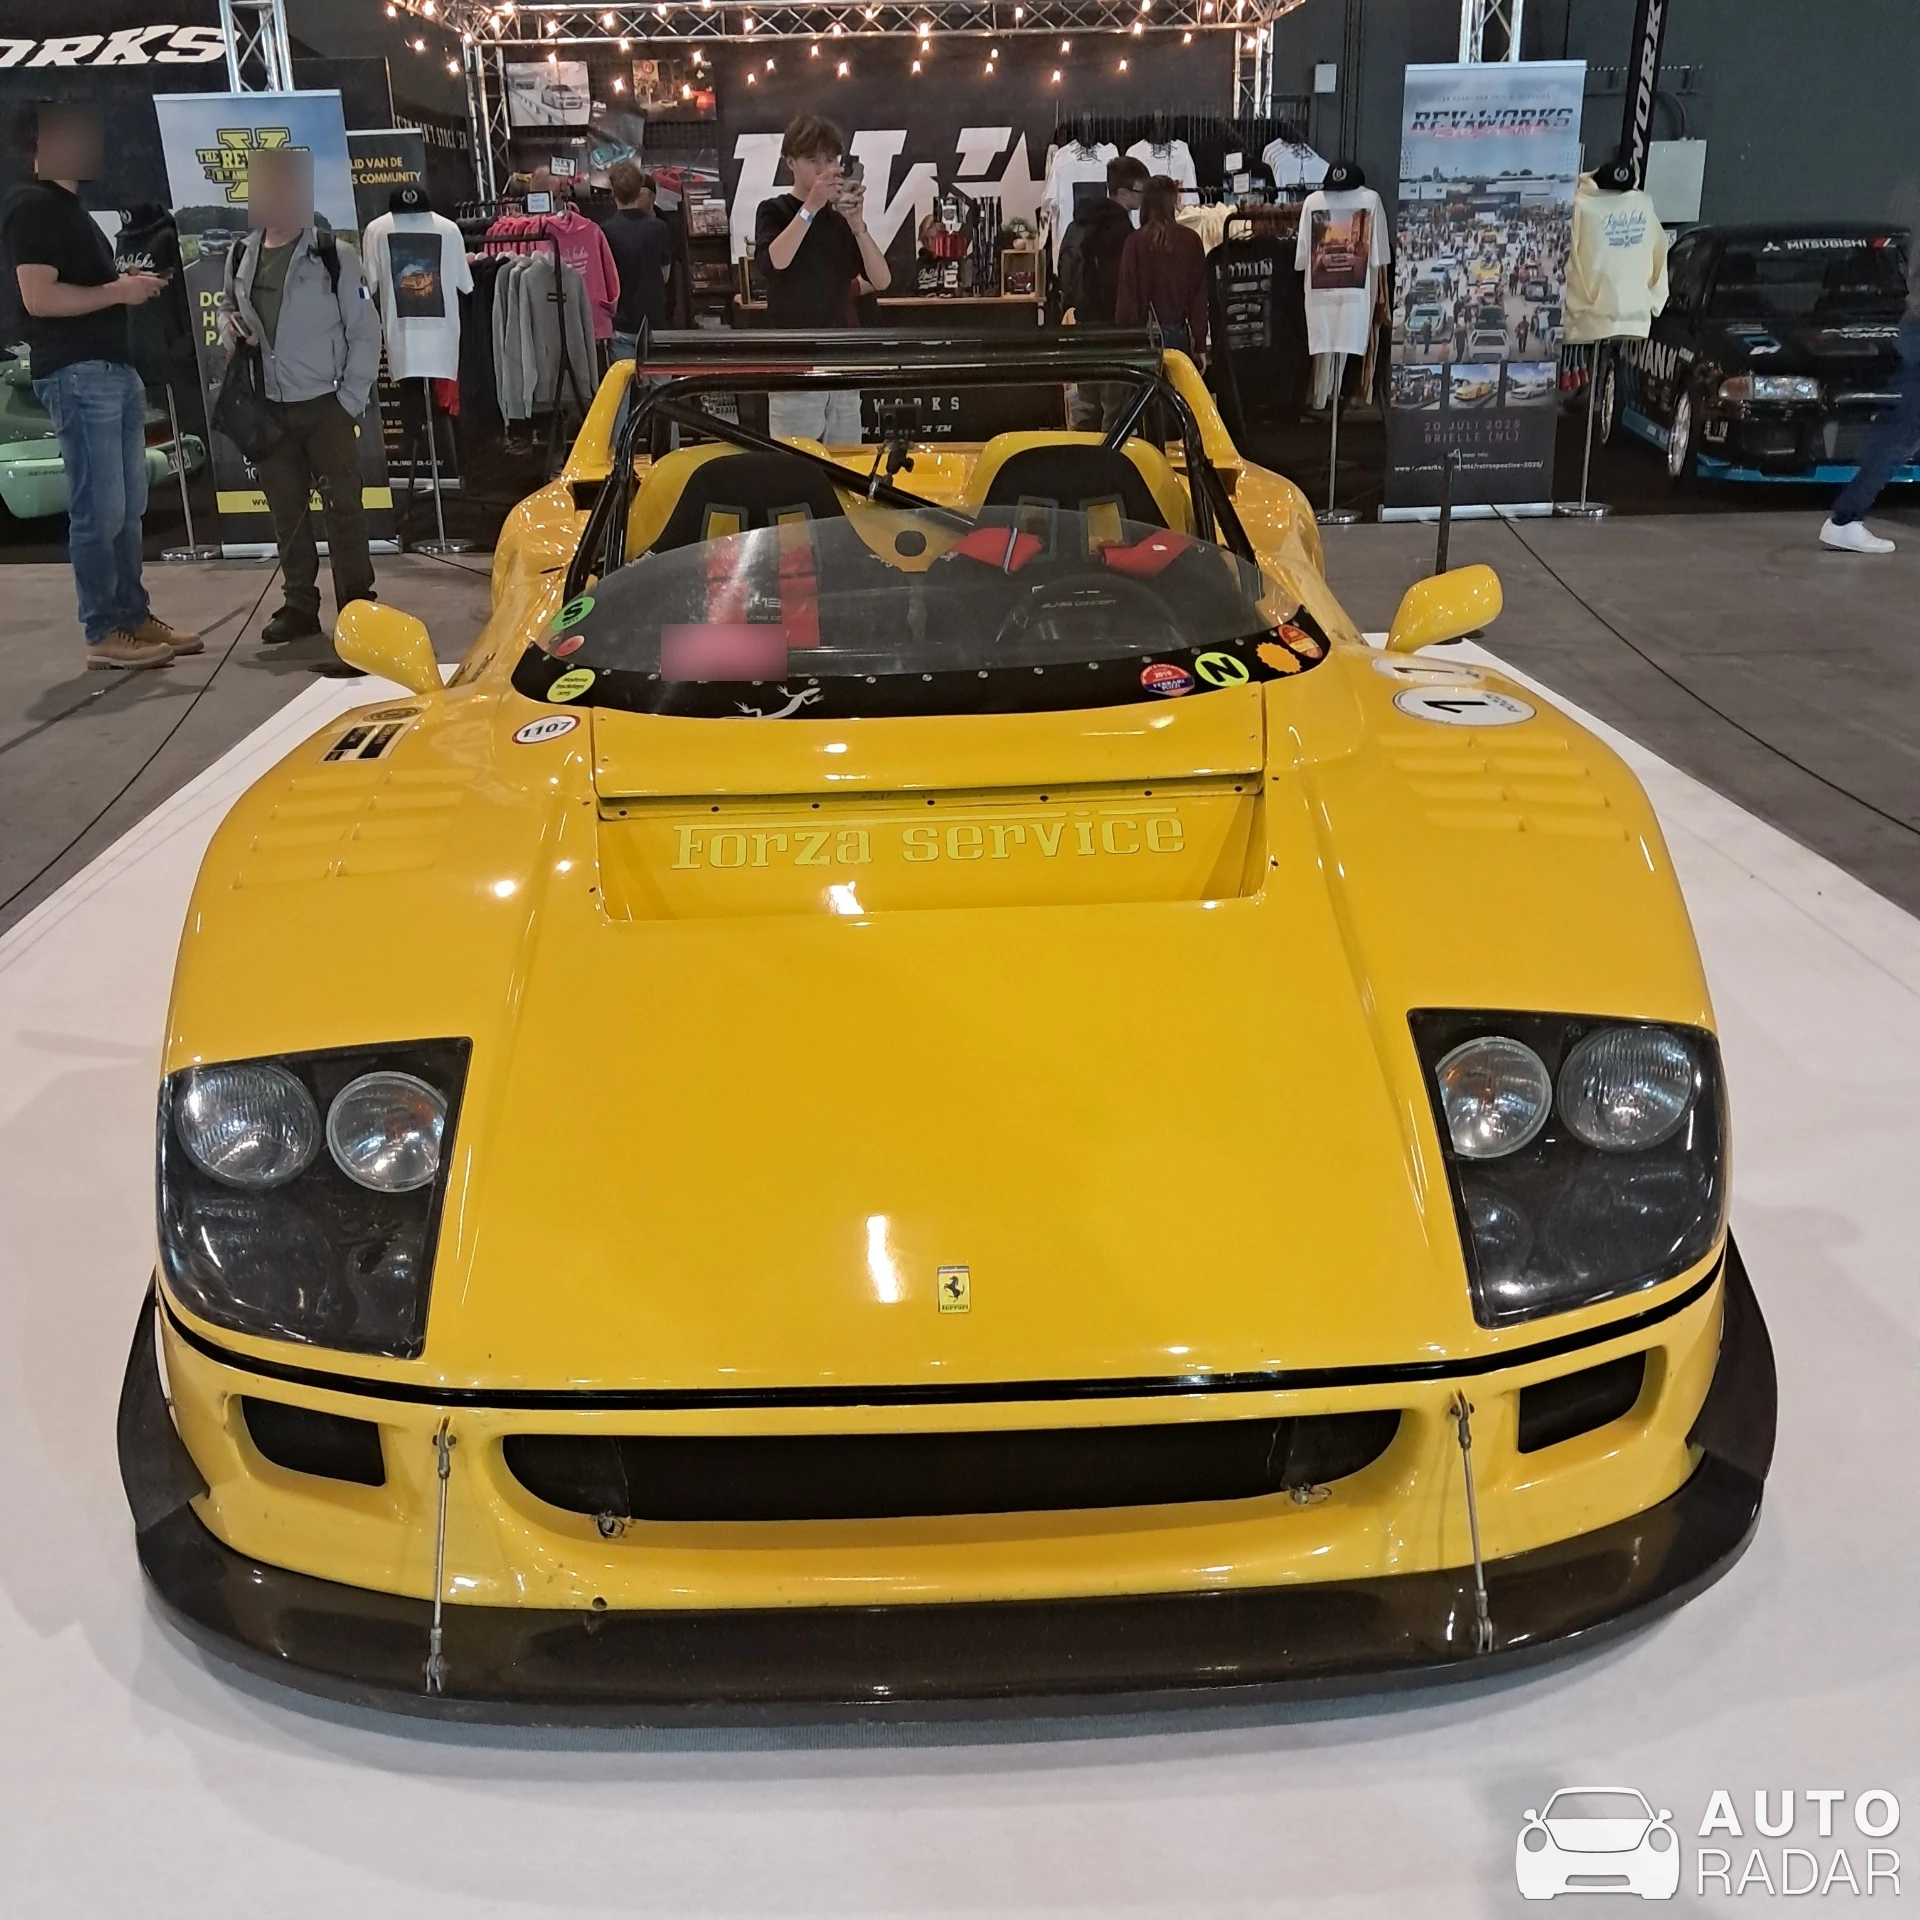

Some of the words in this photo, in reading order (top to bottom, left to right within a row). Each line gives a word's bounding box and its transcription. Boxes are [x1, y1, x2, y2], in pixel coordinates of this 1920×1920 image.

[1412, 108, 1574, 131] REVAWORKS
[198, 150, 220, 163] THE
[365, 157, 389, 169] VAN
[390, 156, 403, 168] DE
[360, 170, 422, 184] COMMUNITY
[1786, 237, 1867, 250] MITSUBISHI
[1424, 421, 1441, 432] 20
[1449, 420, 1478, 431] JULI
[1424, 432, 1480, 444] BRIELLE
[562, 602, 584, 622] S
[1200, 656, 1245, 683] N
[522, 720, 573, 738] 1107
[670, 824, 873, 869] Forza
[902, 811, 1186, 863] service
